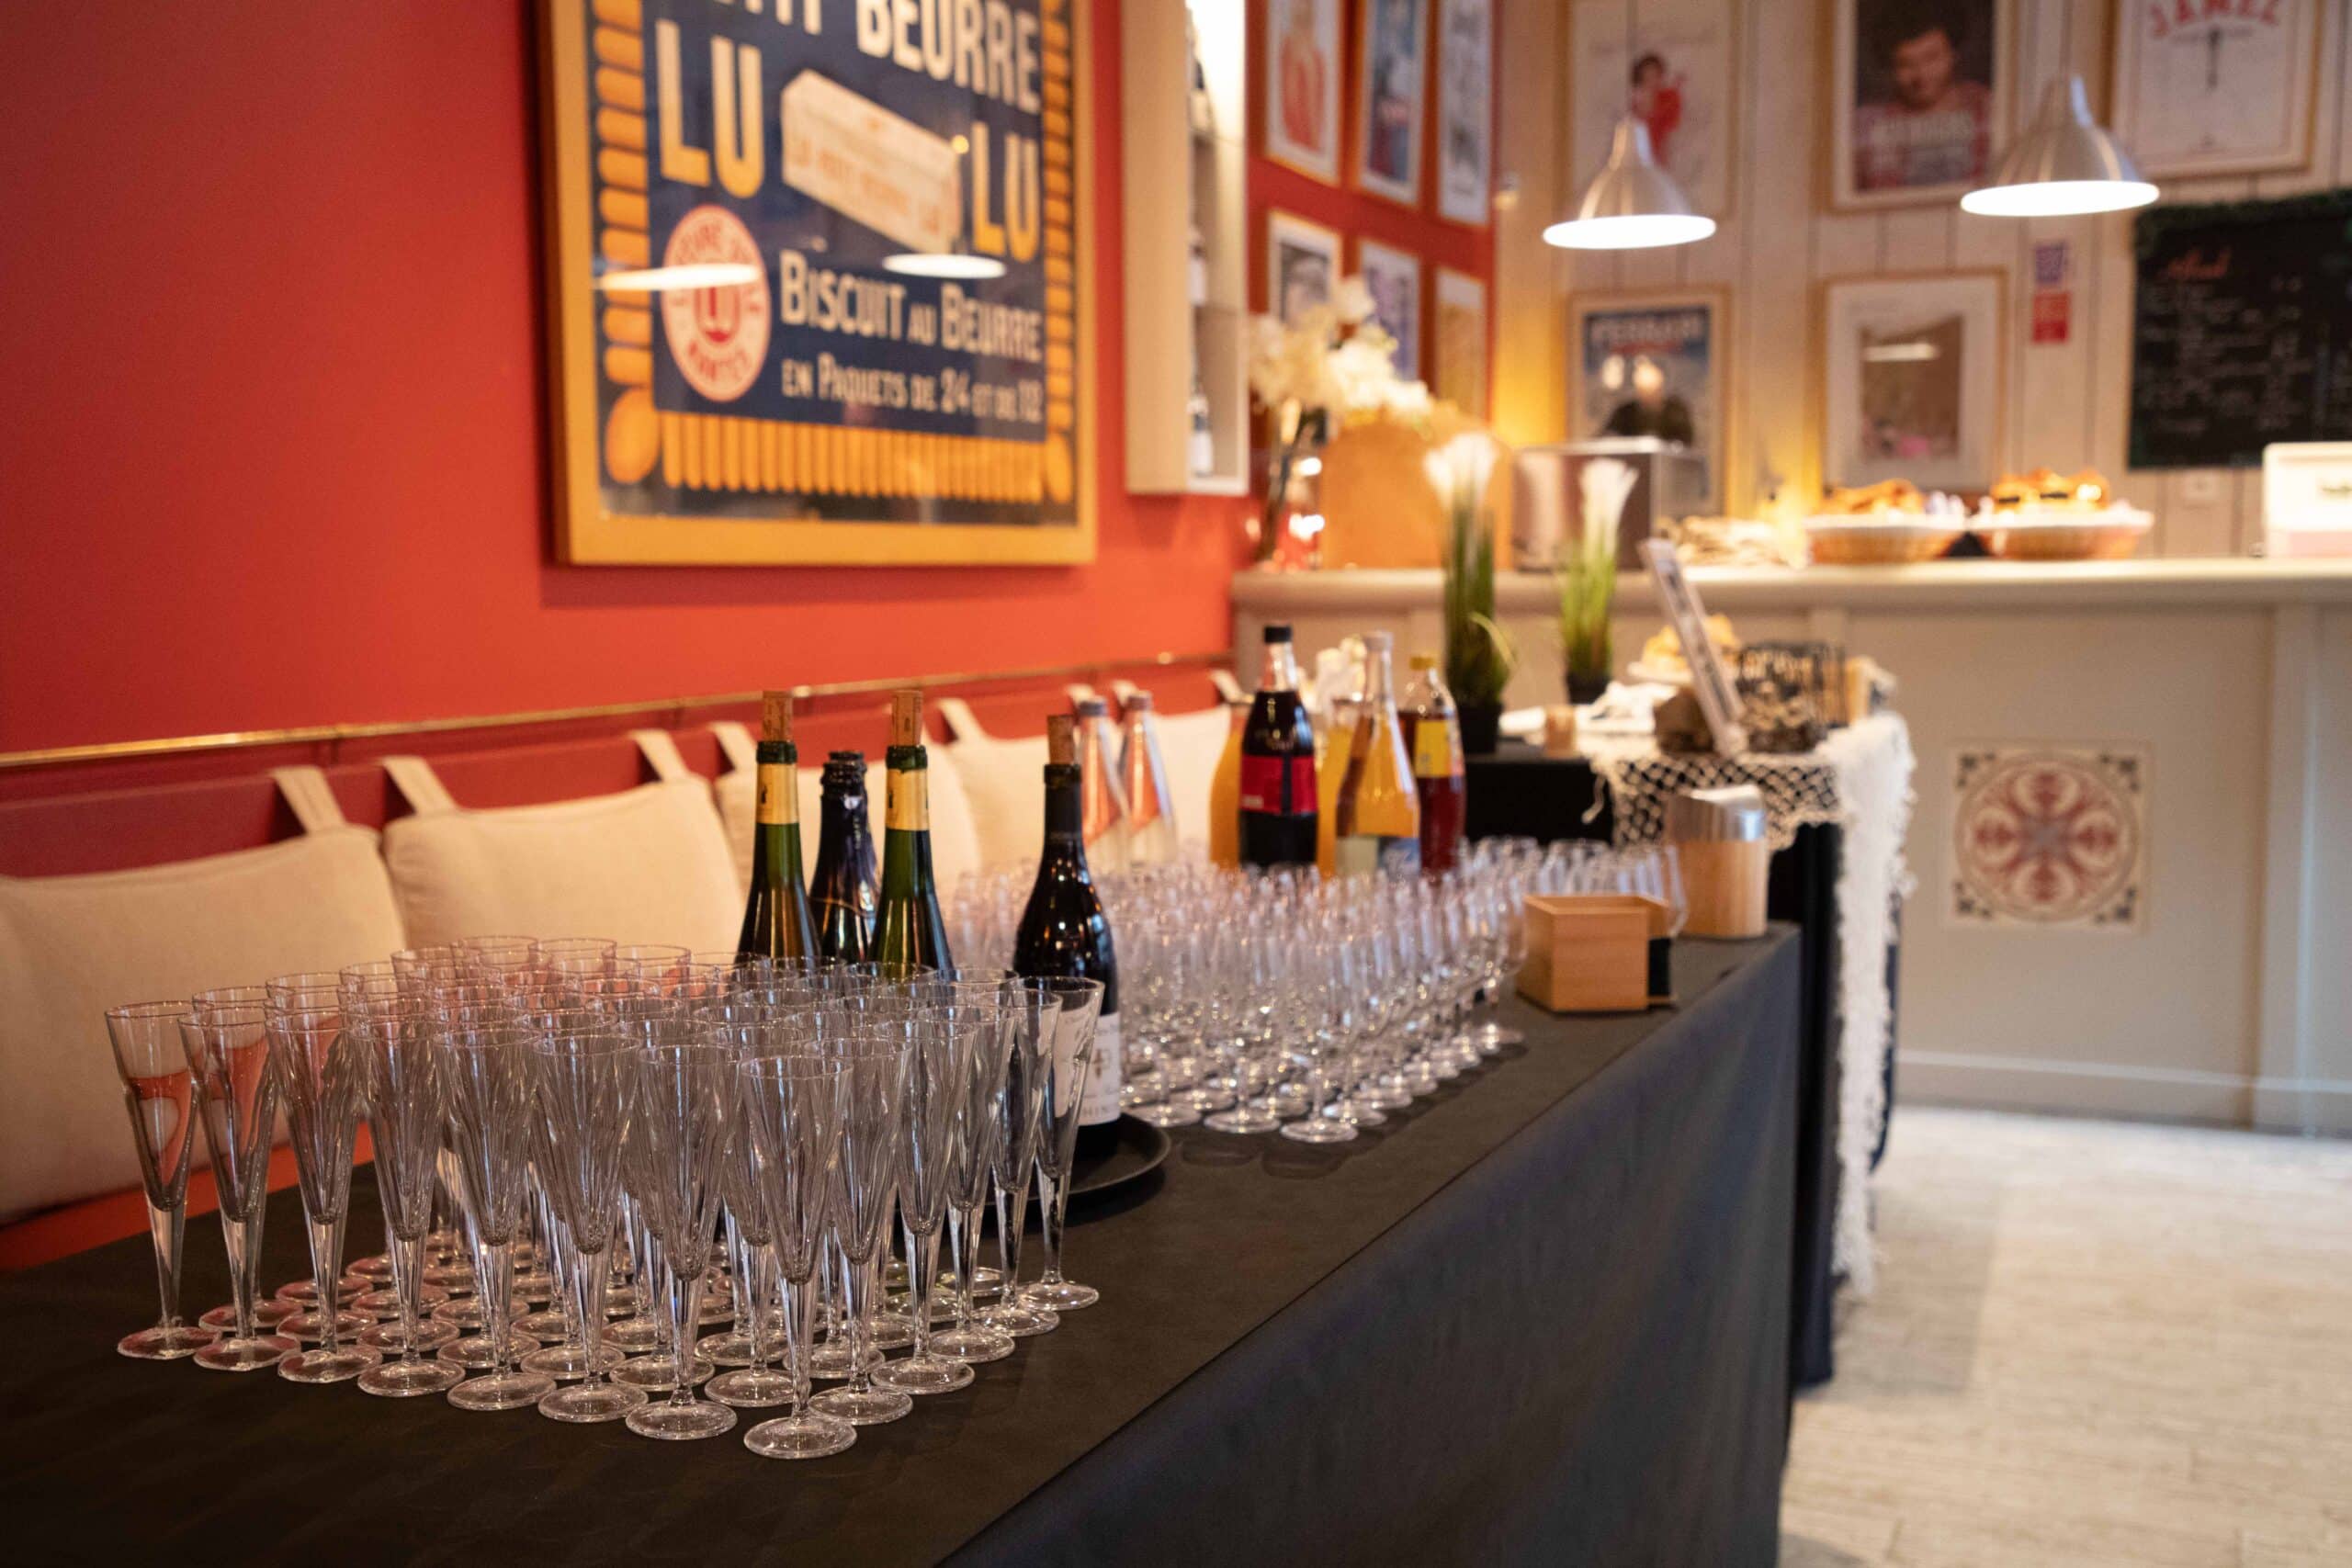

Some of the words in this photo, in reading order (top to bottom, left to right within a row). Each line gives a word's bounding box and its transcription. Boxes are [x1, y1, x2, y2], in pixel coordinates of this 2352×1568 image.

[655, 17, 764, 198] LU
[855, 0, 1041, 115] BEURRE
[972, 121, 1040, 263] LU
[779, 249, 906, 340] BISCUIT
[907, 302, 937, 345] AU
[941, 281, 1043, 363] BEURRE
[782, 358, 813, 398] EN
[818, 351, 908, 410] PAQUETS
